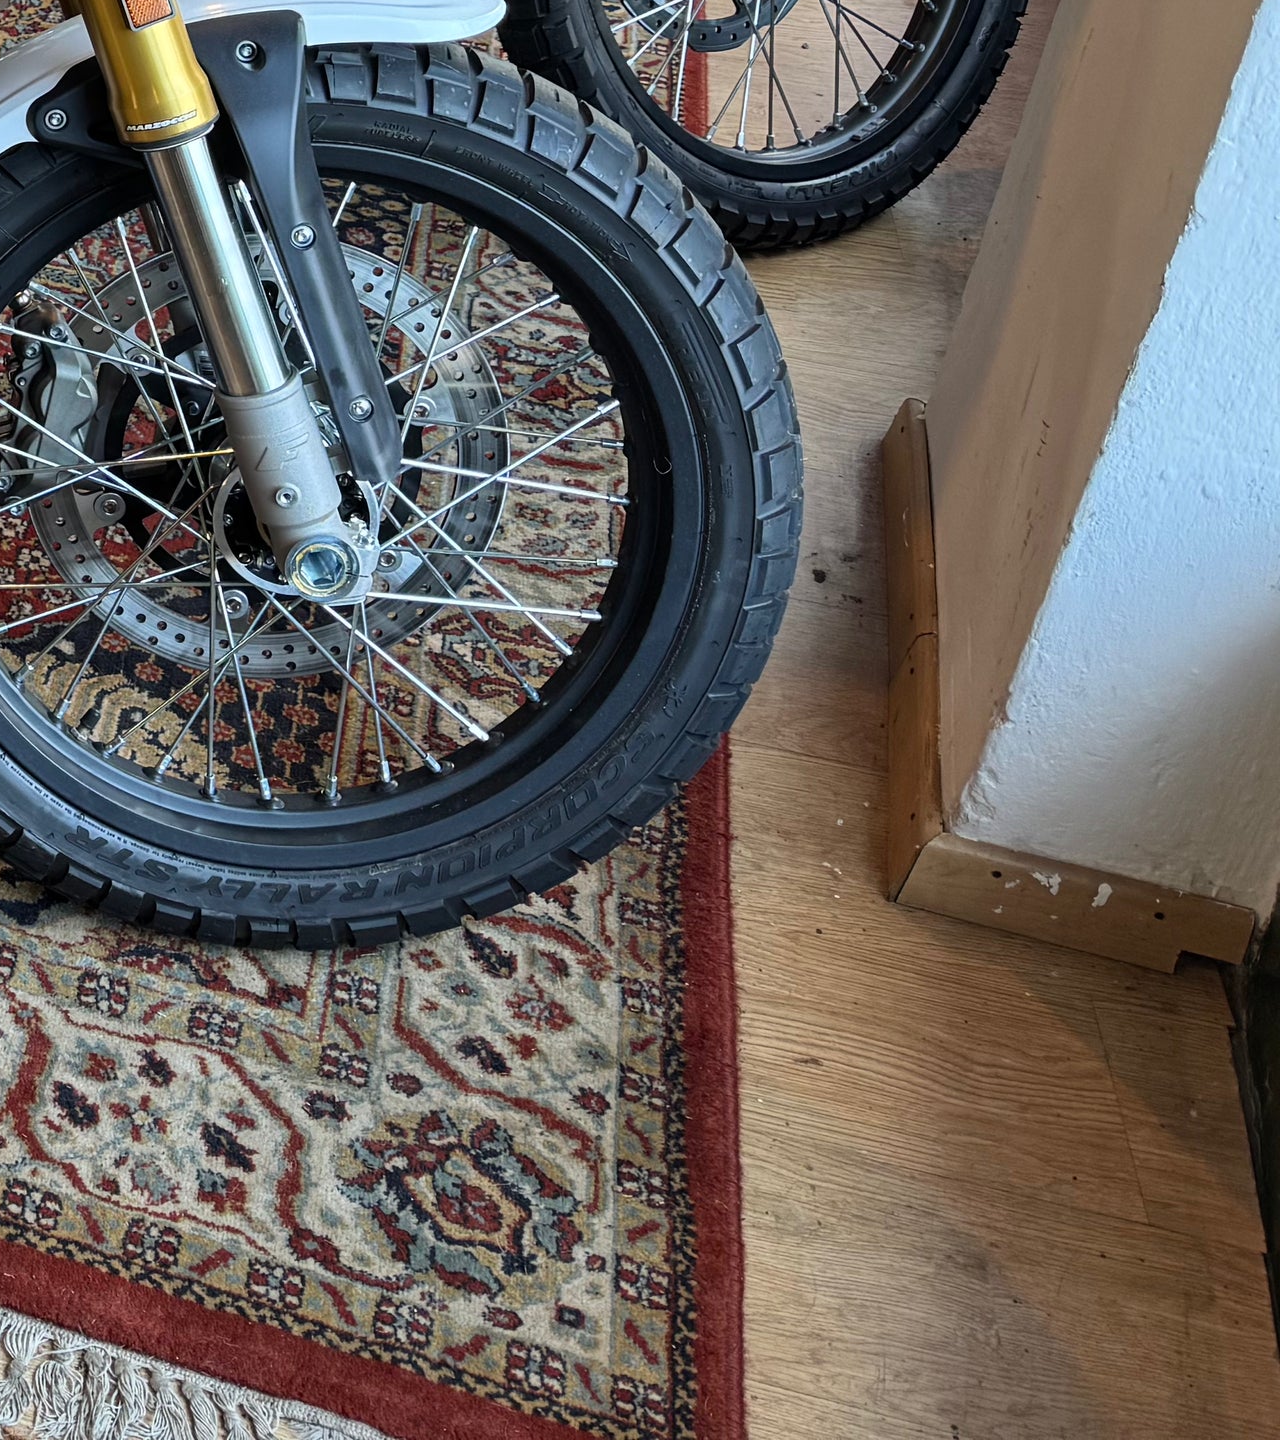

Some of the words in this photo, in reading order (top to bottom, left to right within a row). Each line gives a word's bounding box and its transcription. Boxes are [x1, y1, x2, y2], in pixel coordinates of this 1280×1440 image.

[393, 730, 650, 898] SCORPION
[64, 824, 180, 884] STR
[190, 878, 382, 908] RALLY
